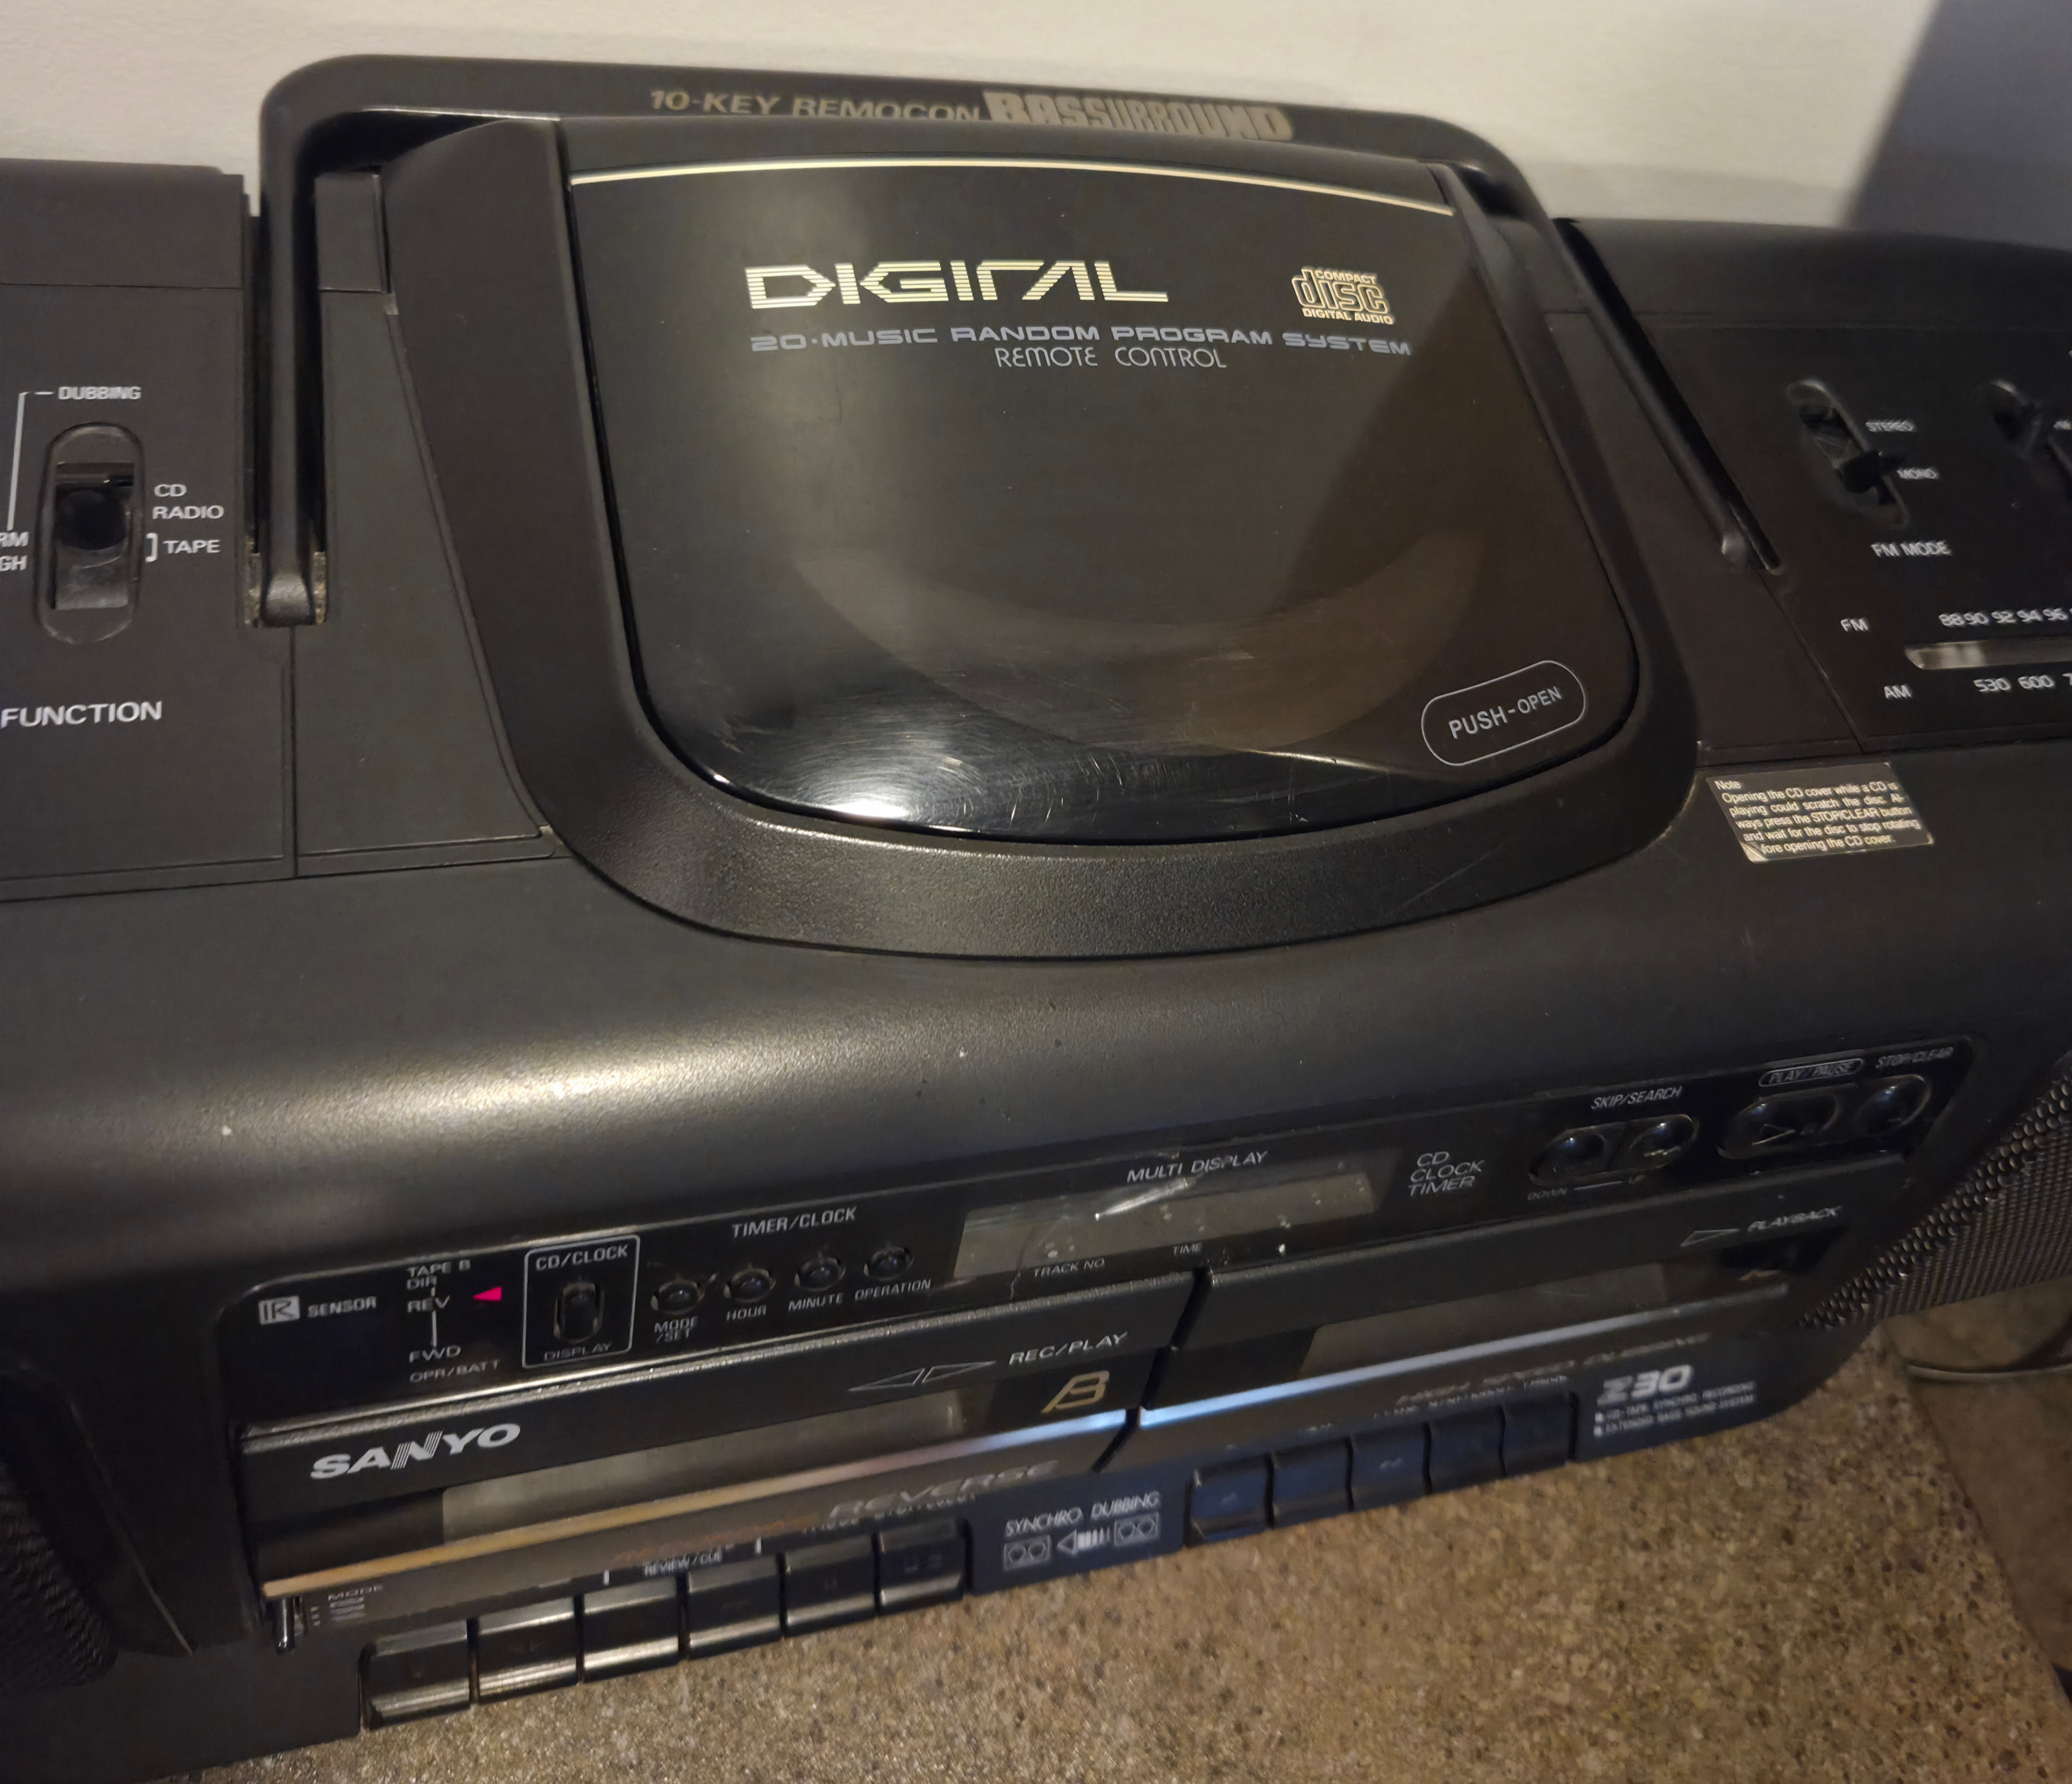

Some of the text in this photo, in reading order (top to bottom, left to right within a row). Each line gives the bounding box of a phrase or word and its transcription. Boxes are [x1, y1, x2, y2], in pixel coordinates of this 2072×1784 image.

[650, 90, 782, 115] 10-KEY
[792, 97, 980, 121] REMOCON
[745, 260, 1168, 308] DIGITAL
[1314, 269, 1377, 284] COMPACT
[1302, 308, 1394, 325] DIGITAL AUDIO
[950, 326, 1100, 342] RANDOM
[1111, 326, 1272, 345] PROGRAM
[1282, 332, 1411, 356] SYSTEM
[995, 347, 1227, 368] REMOTE CONTROL
[58, 386, 142, 401] DUBBING
[1865, 419, 1915, 433] STEREO
[1898, 468, 1939, 479] MONO
[154, 484, 187, 497] CD
[153, 505, 224, 520] RADIO
[0, 531, 29, 547] RM
[163, 540, 221, 554] TAPE
[1871, 540, 1952, 558] FM MODE
[0, 555, 27, 571] GH
[1840, 618, 1869, 632] FM
[1938, 607, 2069, 628] 88 90 92 94 96
[1883, 684, 1913, 699] AM
[1973, 677, 2012, 693] 530
[2018, 674, 2056, 690] 600
[1, 700, 162, 728] FUNCTION
[1448, 686, 1563, 739] PUSH-OPEN
[1714, 780, 1741, 790] Note
[1722, 792, 1768, 804] Opening
[1767, 790, 1785, 800] the
[1785, 788, 1803, 798] CD
[1805, 787, 1832, 797] cover
[1833, 784, 1861, 795] while
[1869, 782, 1886, 791] CD
[1887, 782, 1898, 790] is
[1729, 805, 1768, 818] playing
[1770, 801, 1800, 812] could
[1802, 798, 1839, 810] scratch
[1842, 797, 1860, 807] the
[1735, 807, 1912, 830] ways press the STOP/CLEAR button
[1743, 819, 1921, 842] and wait for the disc to stop rotating
[1761, 843, 1783, 855] fore
[1784, 840, 1827, 854] opening
[1826, 838, 1845, 848] the
[1845, 836, 1863, 846] CD
[1590, 1085, 1684, 1110] SKIP/SEARCH
[1127, 1150, 1269, 1183] MULTI DISPLAY
[1417, 1151, 1449, 1167] CD
[1411, 1160, 1486, 1182] CLOCK
[1408, 1175, 1475, 1196] TIMER
[732, 1205, 857, 1238] TIMER/CLOCK
[536, 1244, 629, 1271] CD/CLOCK
[1173, 1243, 1201, 1256] TIME
[407, 1261, 451, 1278] TAPE
[1034, 1263, 1078, 1277] TRACK
[855, 1279, 931, 1302] OPERATION
[308, 1296, 376, 1318] SENSOR
[407, 1295, 450, 1313] REV
[787, 1292, 844, 1312] MINUTE
[726, 1305, 767, 1321] HOUR
[654, 1315, 699, 1334] MODE
[409, 1345, 461, 1363] FWD
[1008, 1331, 1127, 1365] REC/PLAY
[310, 1423, 520, 1479] SANYO
[1005, 1507, 1083, 1538] SYNCHRO
[1091, 1490, 1161, 1520] DUBBING
